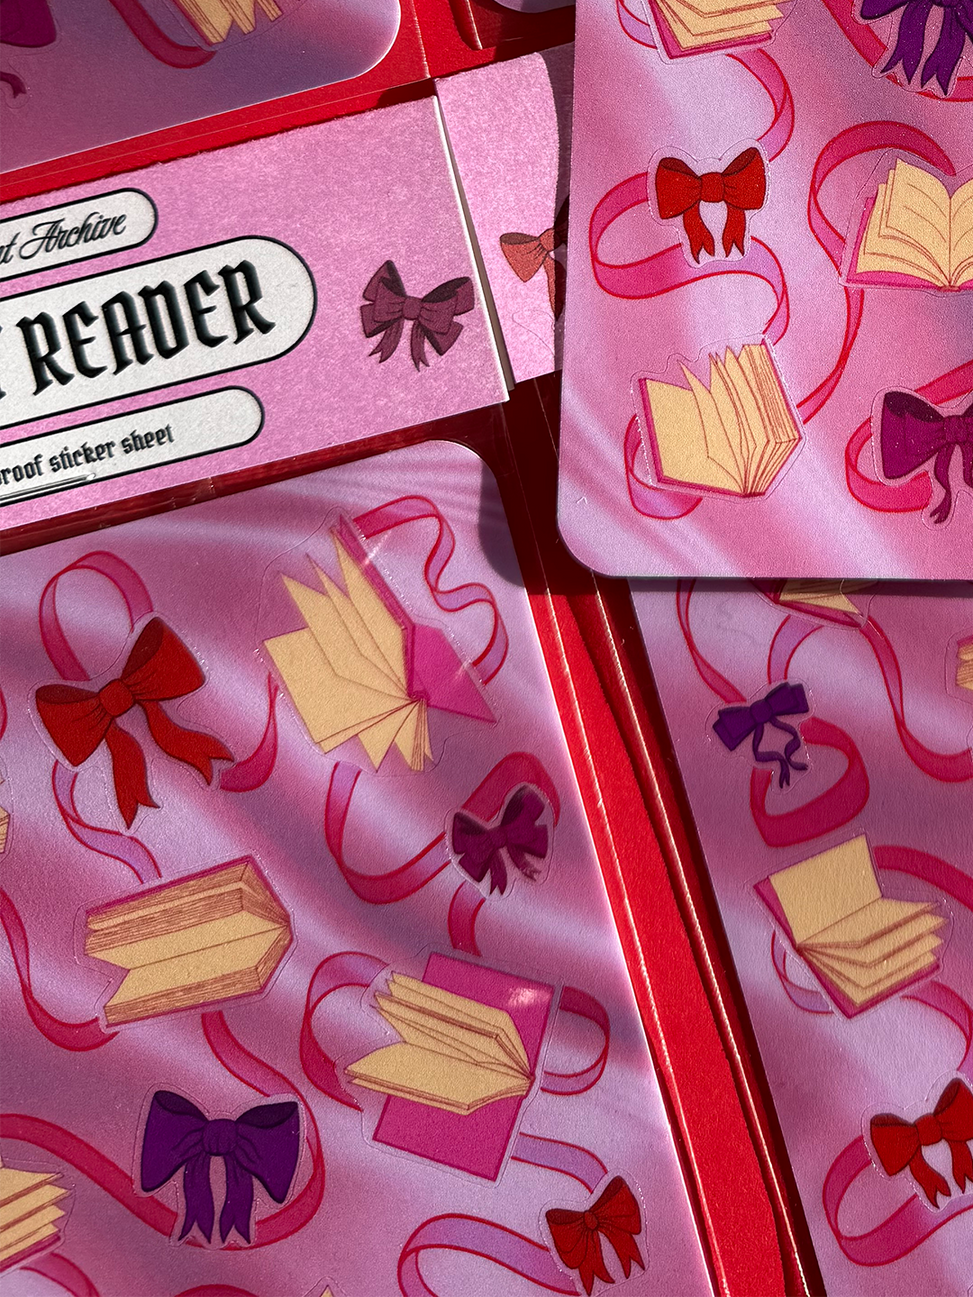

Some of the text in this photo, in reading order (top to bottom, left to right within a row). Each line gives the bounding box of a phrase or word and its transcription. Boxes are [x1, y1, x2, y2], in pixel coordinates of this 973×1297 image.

[19, 211, 127, 260] Archive
[15, 259, 276, 396] READER
[49, 439, 116, 472] sticker
[121, 423, 175, 454] sheet
